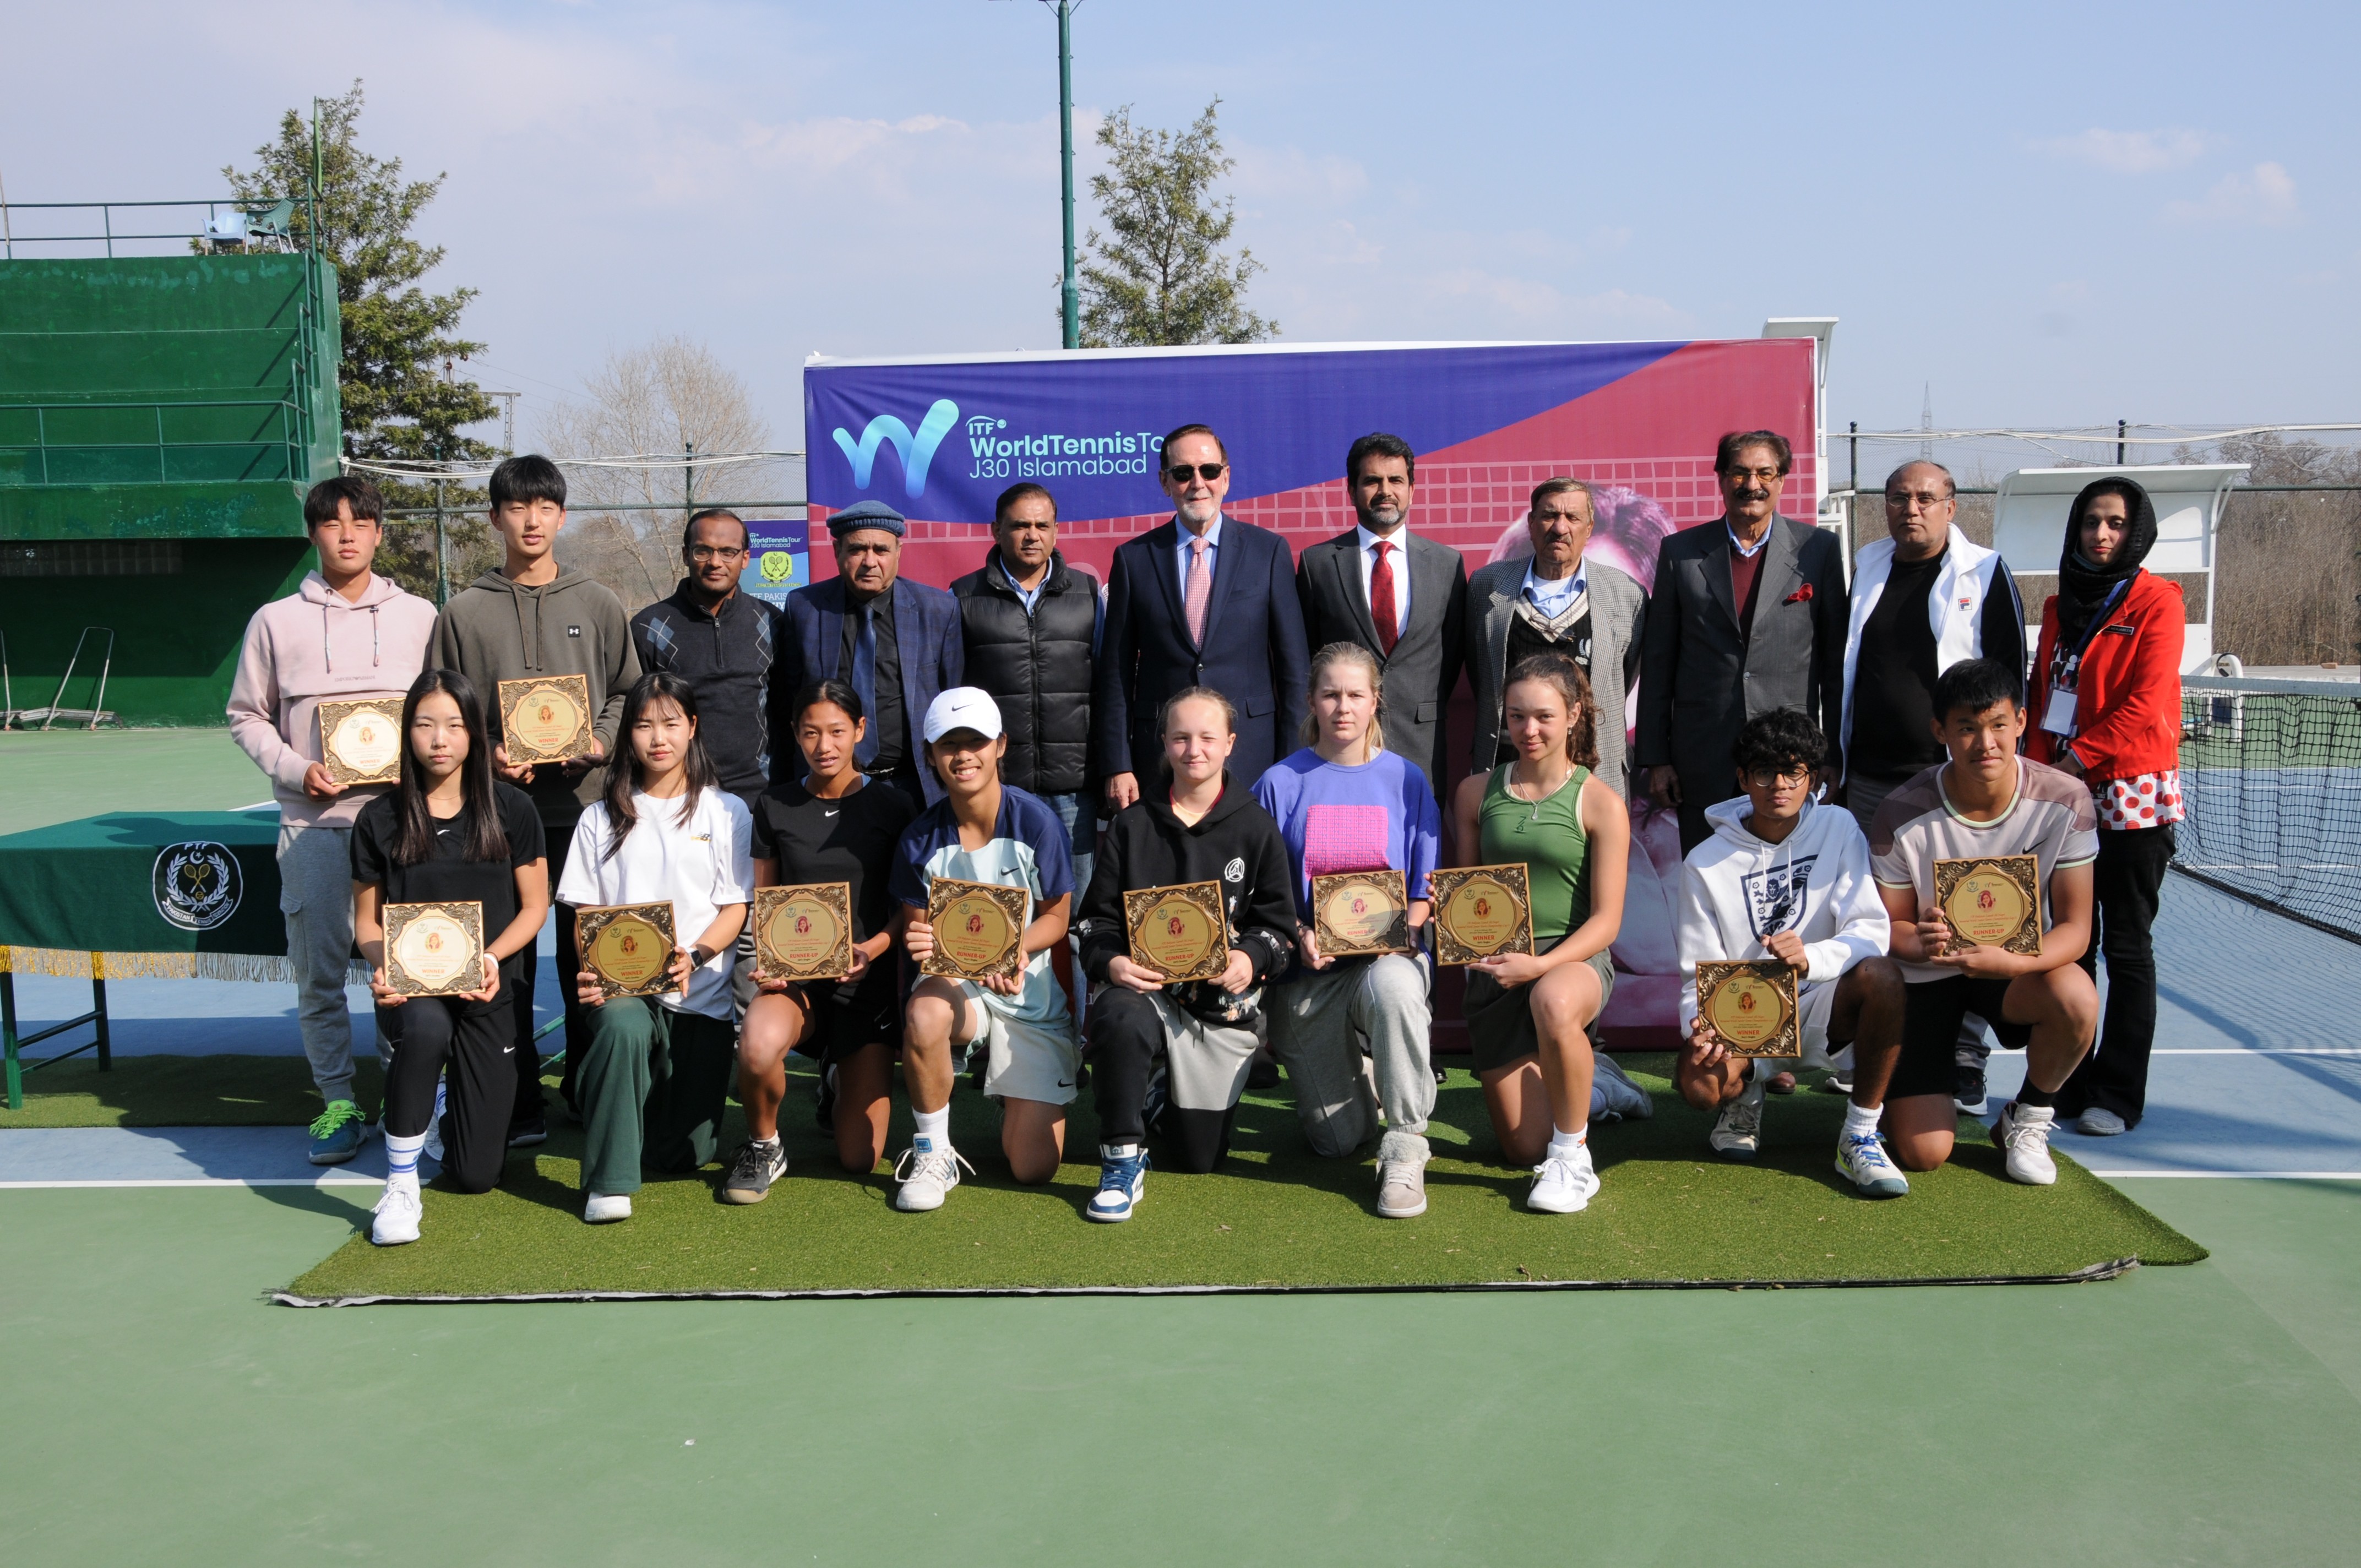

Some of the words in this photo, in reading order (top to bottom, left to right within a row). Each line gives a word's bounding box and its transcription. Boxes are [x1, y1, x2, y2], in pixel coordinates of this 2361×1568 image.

[969, 422, 994, 435] ITF
[969, 459, 1010, 478] J30
[1018, 454, 1146, 477] Islamabad
[167, 906, 191, 920] PAKISTAN
[1165, 953, 1194, 961] RUNNER-UP
